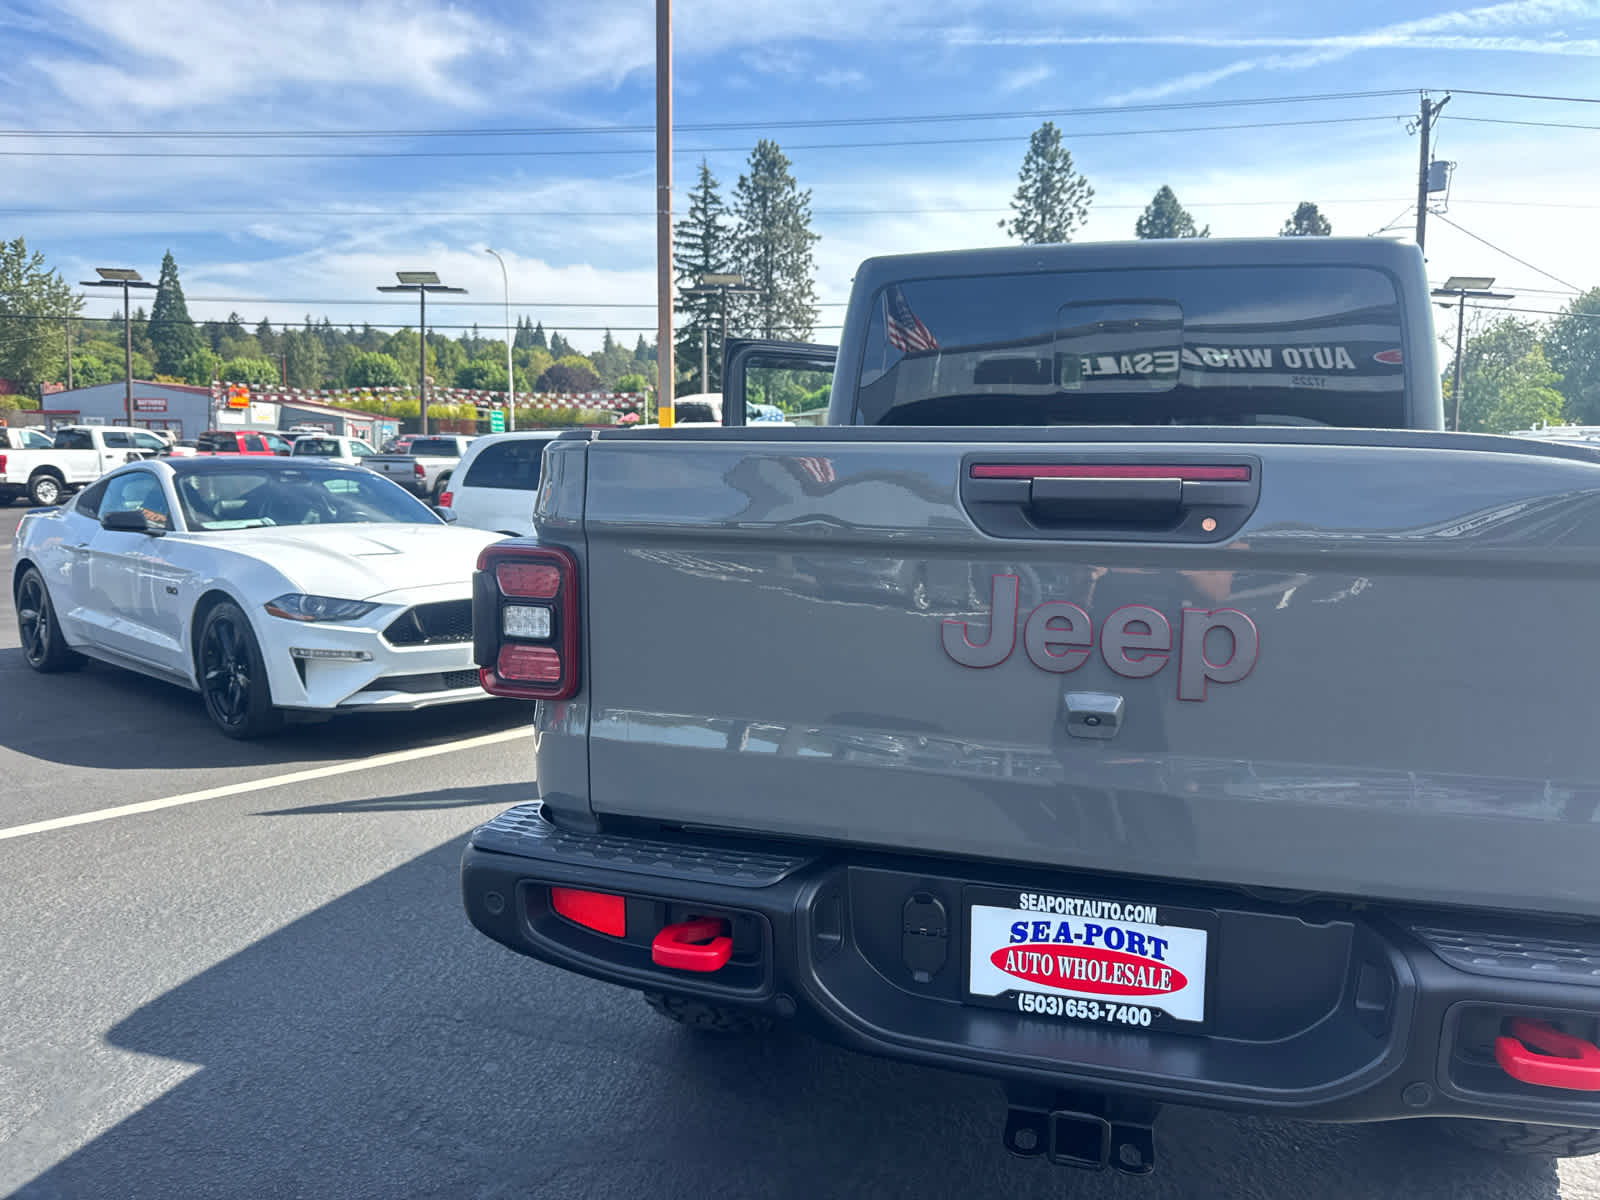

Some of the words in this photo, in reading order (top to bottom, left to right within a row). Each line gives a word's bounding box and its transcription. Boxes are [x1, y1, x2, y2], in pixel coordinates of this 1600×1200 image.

[941, 574, 1259, 702] Jeep
[1019, 892, 1157, 924] SEAPORTAUTO.COM
[1009, 921, 1169, 961] SEA-PORT
[1004, 950, 1054, 977] AUTO
[1057, 955, 1173, 992] WHOLESALE
